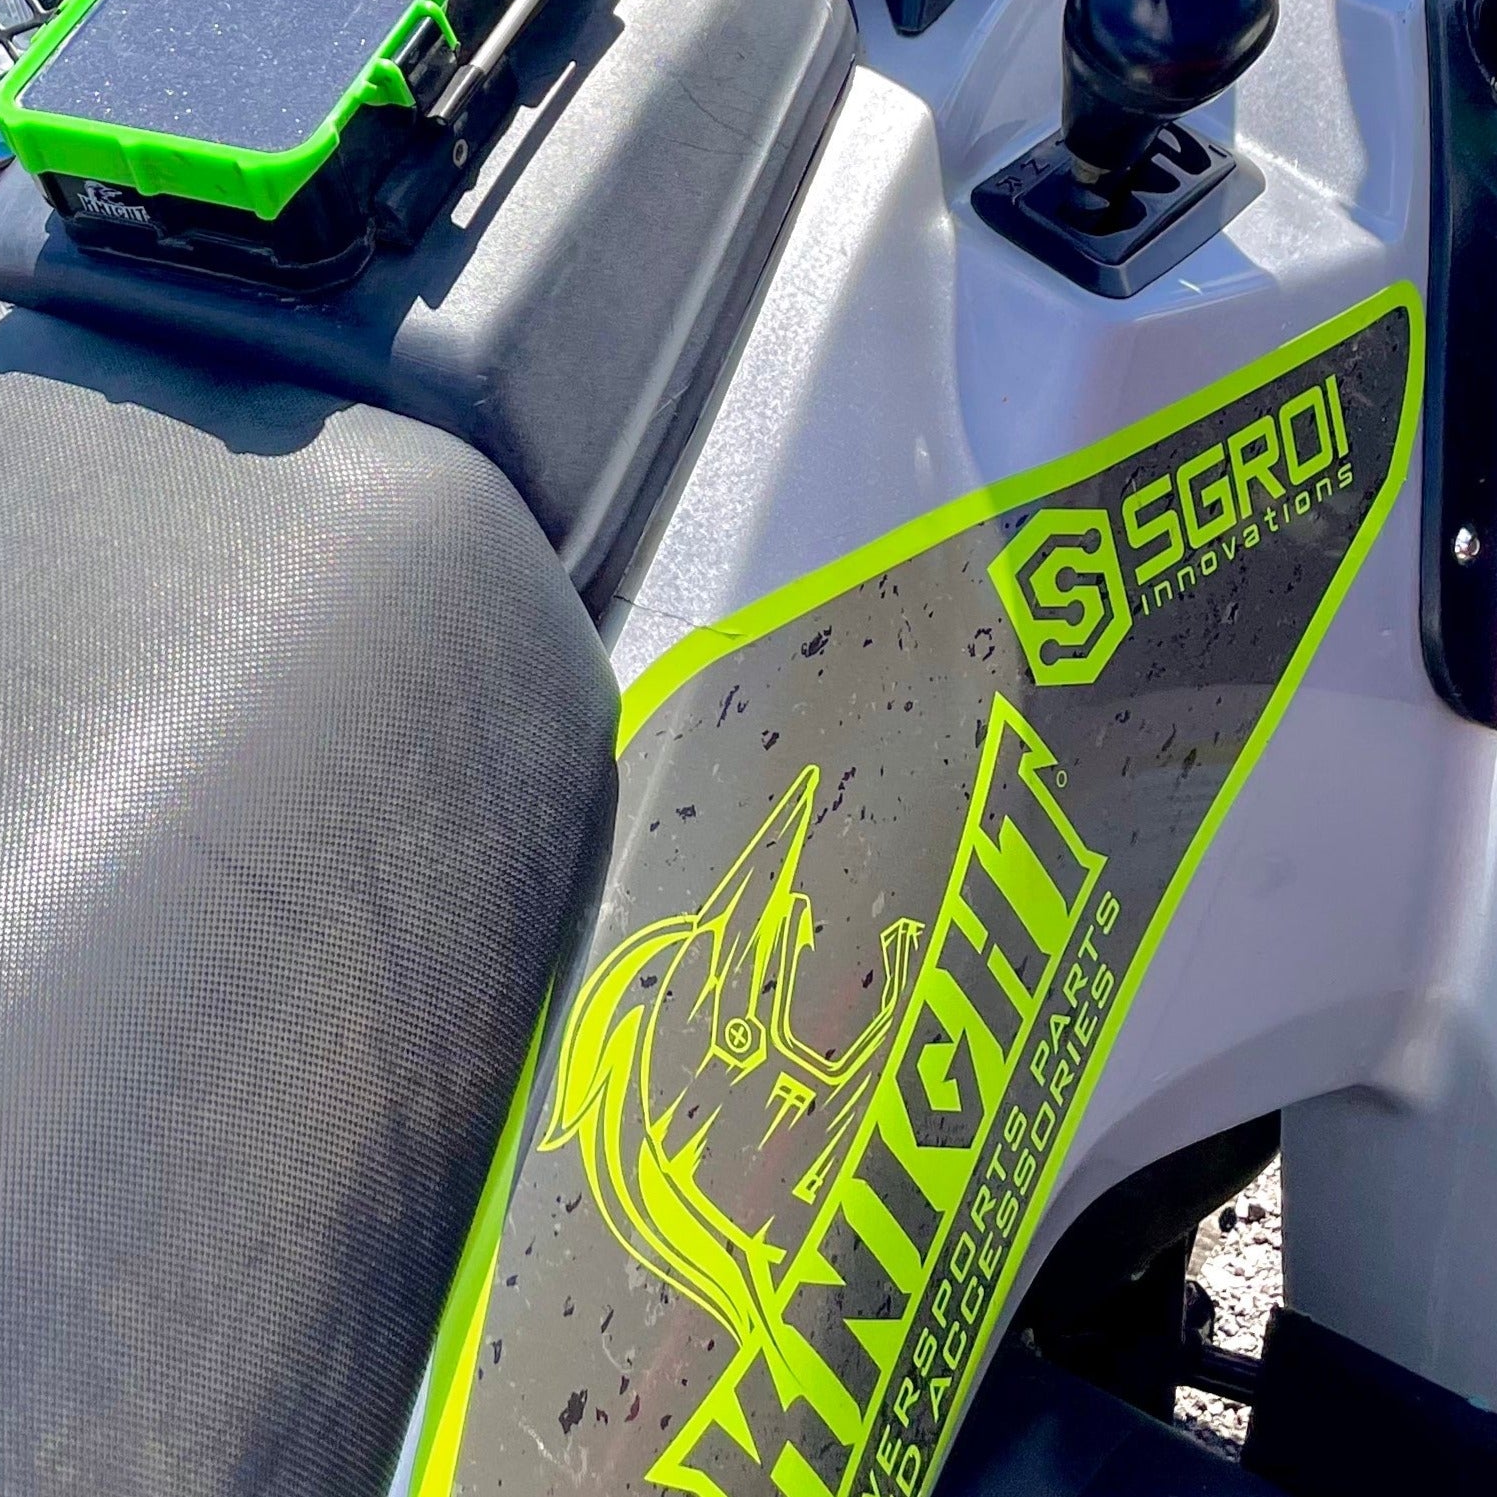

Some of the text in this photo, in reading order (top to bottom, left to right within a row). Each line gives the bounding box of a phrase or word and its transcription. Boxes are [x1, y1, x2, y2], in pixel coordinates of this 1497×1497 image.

[1120, 373, 1350, 587] SGROI
[1029, 890, 1121, 1087] PARTS
[929, 963, 1117, 1423] ACCESSORIES
